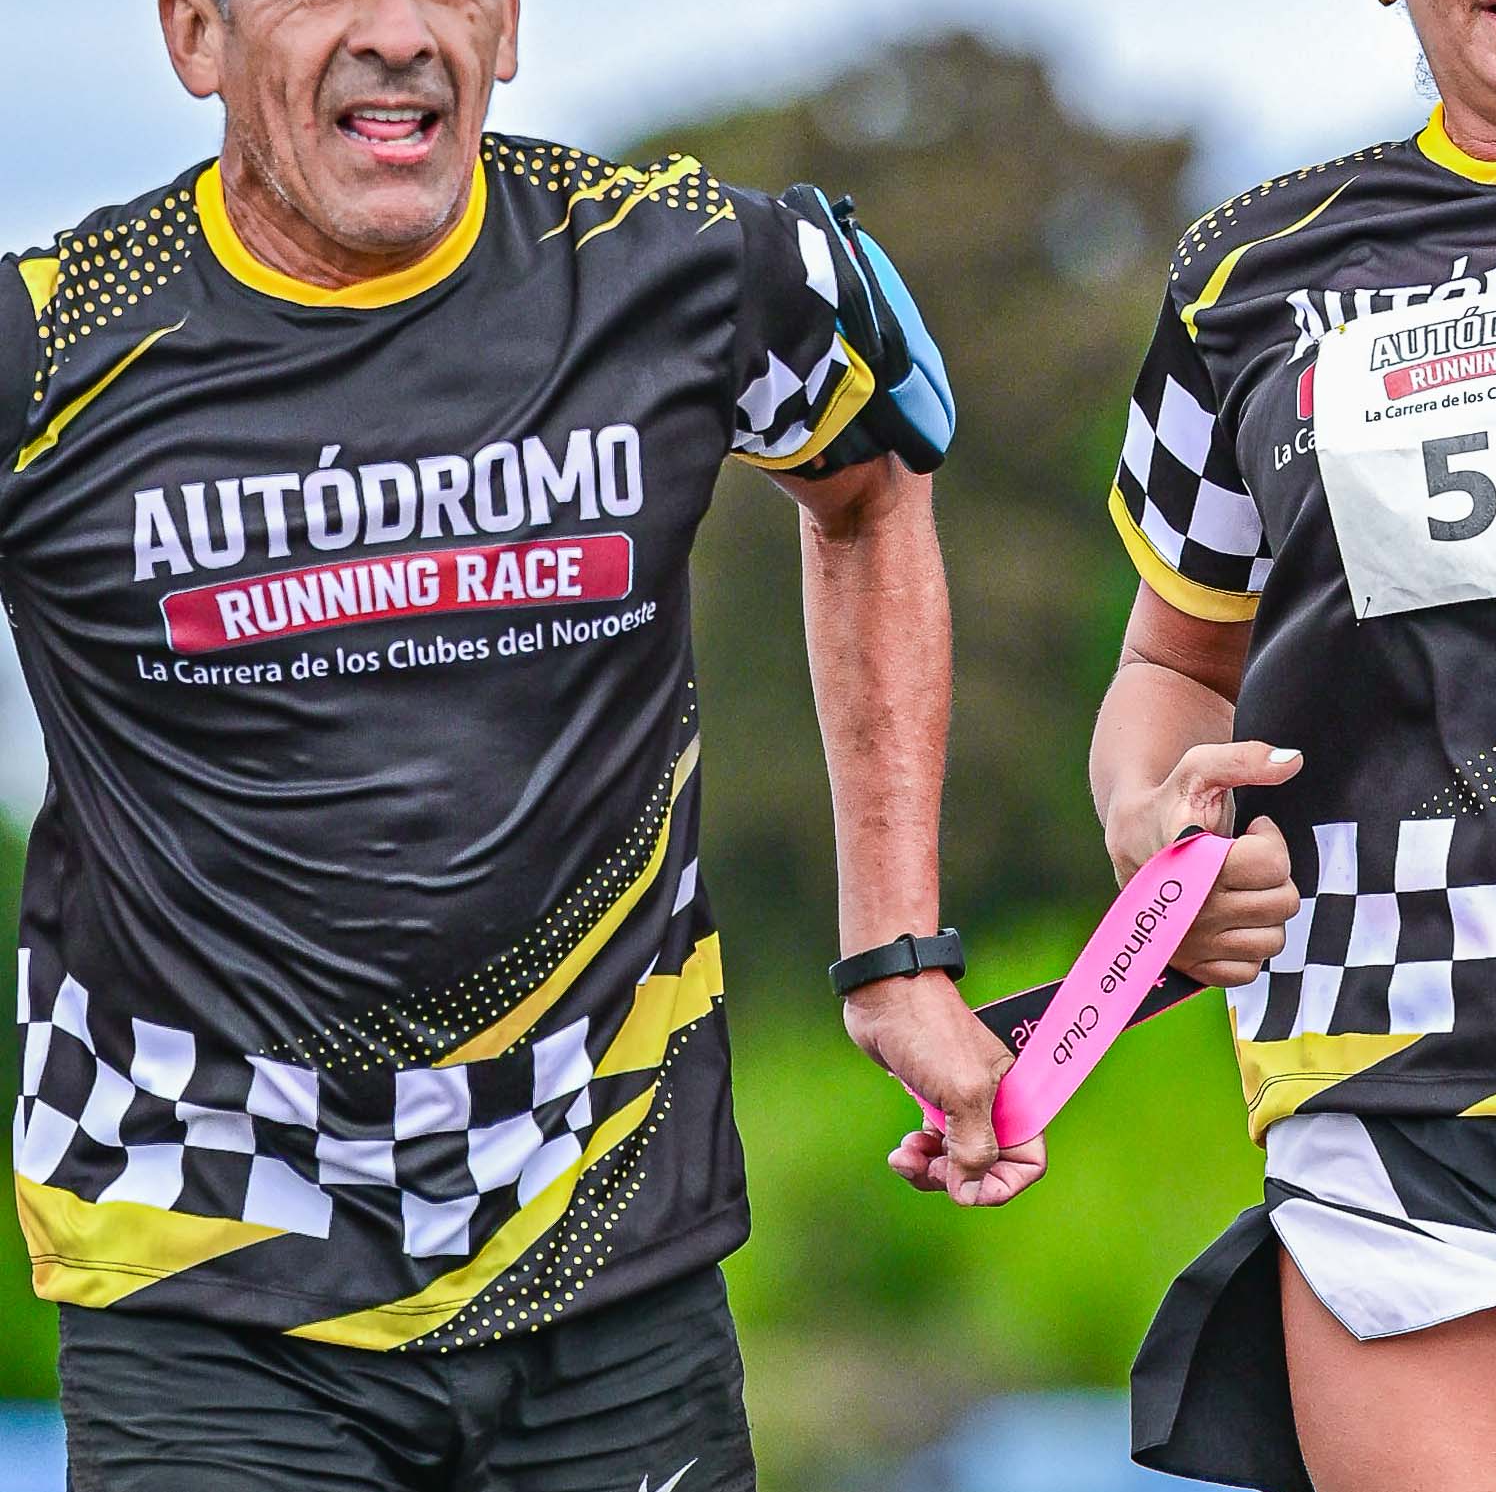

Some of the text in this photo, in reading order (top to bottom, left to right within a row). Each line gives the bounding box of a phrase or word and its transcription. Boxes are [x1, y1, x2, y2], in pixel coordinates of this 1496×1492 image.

[1365, 409, 1381, 422] La
[1385, 400, 1437, 419] Carrera
[1441, 394, 1459, 409] de
[1463, 391, 1483, 405] los
[133, 422, 644, 582] AUTÓDROMO
[1273, 445, 1292, 471] La
[216, 546, 583, 640] RUNNING RACE
[137, 601, 657, 685] La Carrera de los Clubes del Noroeste
[1053, 879, 1183, 1065] Originale Club
